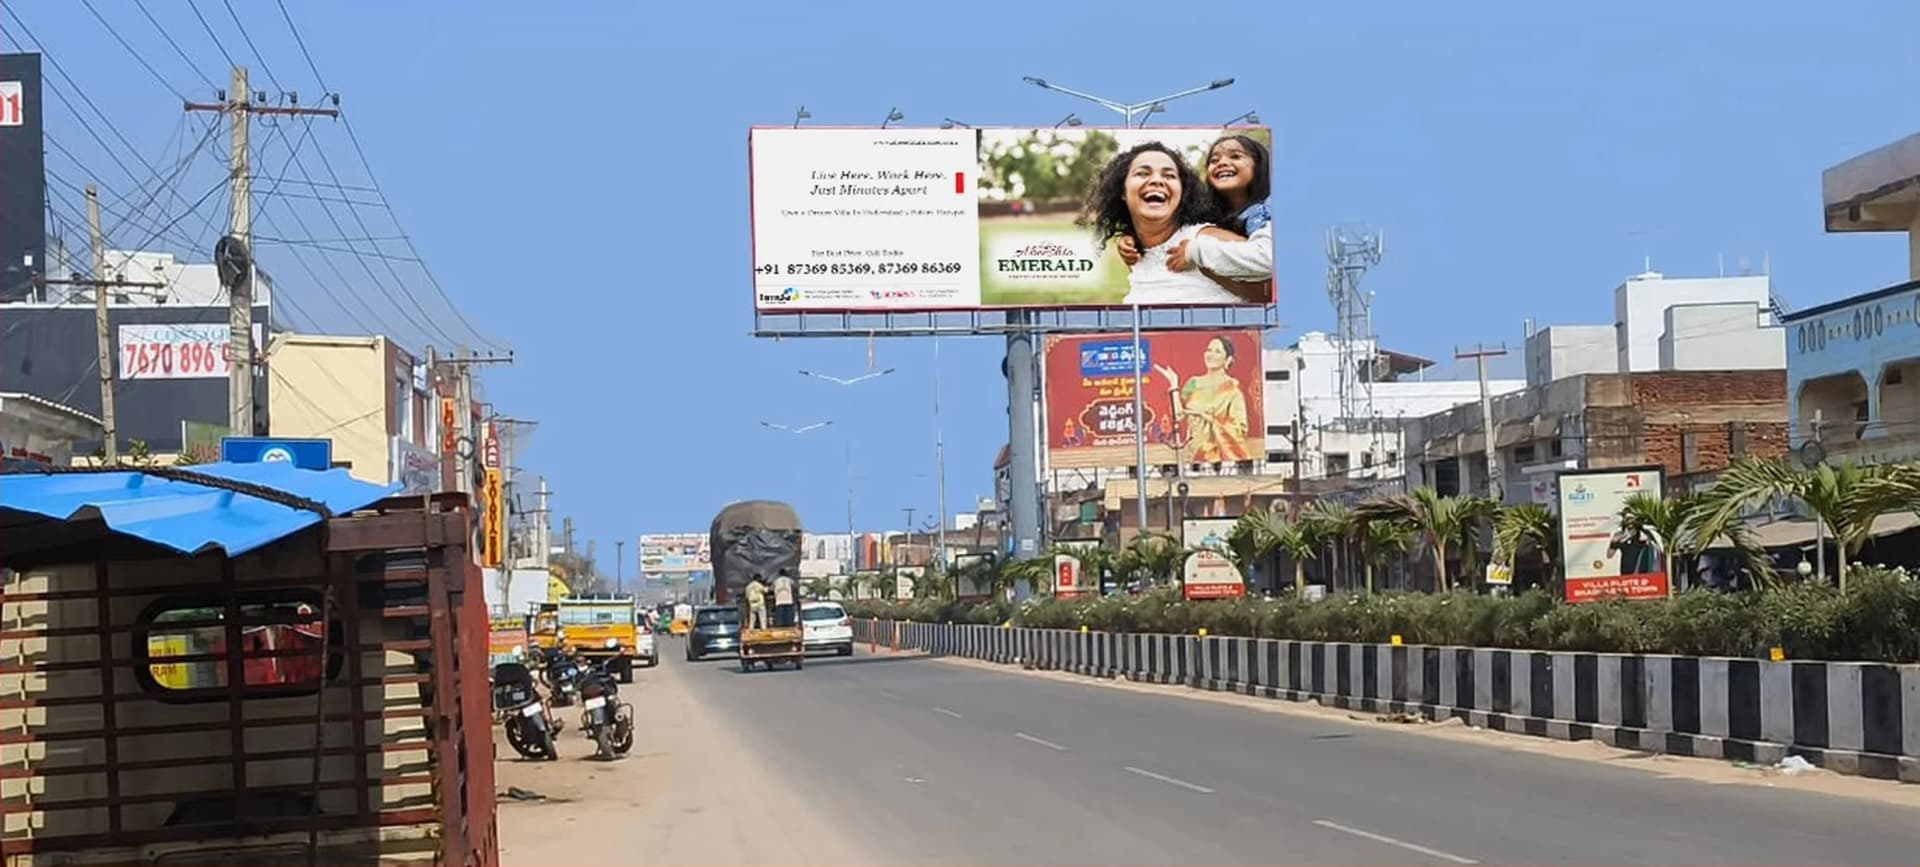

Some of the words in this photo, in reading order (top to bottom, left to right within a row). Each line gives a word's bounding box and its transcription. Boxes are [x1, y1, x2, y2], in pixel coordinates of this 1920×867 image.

[811, 170, 837, 180] Live
[840, 170, 874, 180] Here.
[877, 169, 910, 180] Work
[914, 170, 947, 180] Here.
[810, 184, 836, 196] Just
[839, 184, 890, 196] Minutes
[890, 184, 928, 196] Apart
[756, 264, 779, 275] +91
[787, 263, 828, 275] 87369
[830, 263, 875, 276] 85369,
[878, 262, 919, 274] 87369
[921, 262, 962, 274] 86369
[997, 259, 1094, 272] EMERALD
[126, 343, 172, 374] 7670
[180, 343, 214, 373] 896
